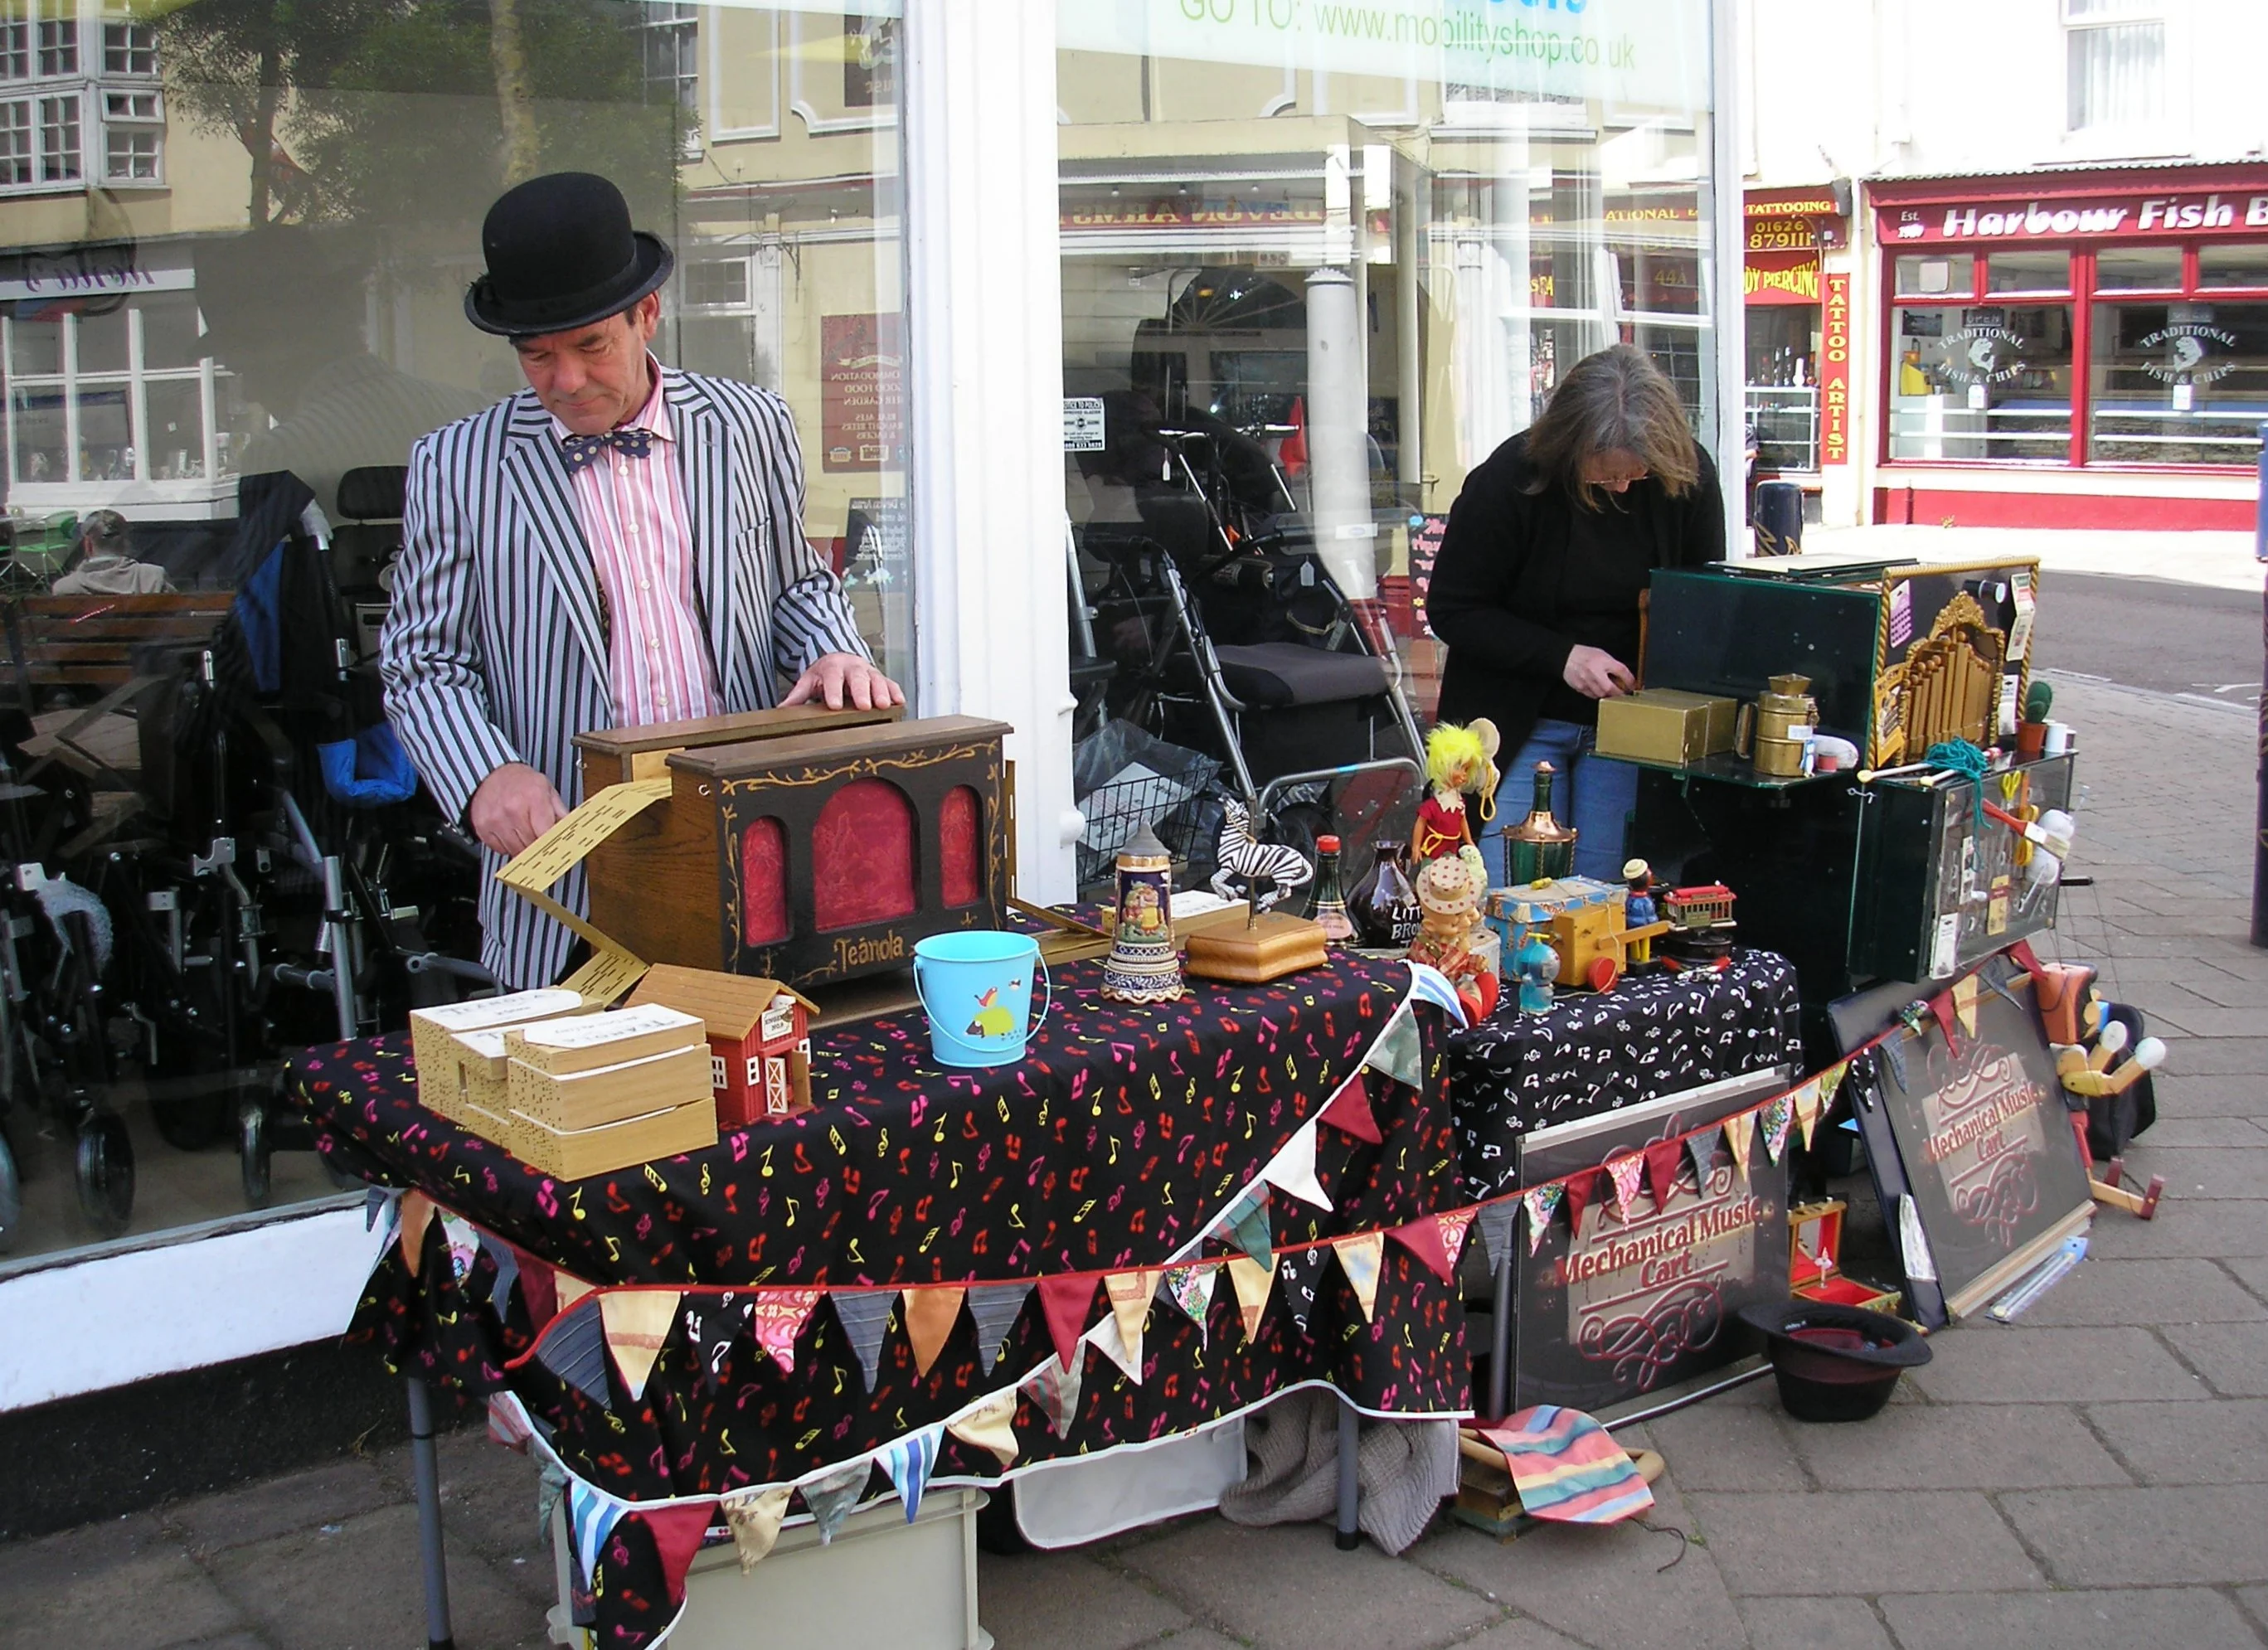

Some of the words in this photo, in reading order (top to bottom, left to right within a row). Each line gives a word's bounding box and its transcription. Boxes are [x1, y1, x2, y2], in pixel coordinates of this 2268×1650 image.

[1315, 7, 1636, 71] www.mobilityshop.co.uk
[1746, 201, 1831, 216] TATTOOING
[1755, 220, 1804, 234] 01626
[1942, 202, 2128, 238] Harbour
[2137, 194, 2234, 230] Fish
[1762, 259, 1819, 301] PIERCING
[1827, 279, 1847, 362] TATTOO
[1938, 327, 2024, 349] TRADITIONAL
[2139, 324, 2236, 348] TRADITIONAL
[1938, 362, 1969, 383] FISH
[1985, 361, 2026, 383] CHIPS
[2140, 362, 2173, 384] FISH
[2176, 374, 2188, 385] &
[2192, 362, 2236, 385] CHIPS
[1827, 377, 1846, 460] ARTIST
[1391, 905, 1424, 921] LITT
[1921, 1099, 2003, 1163] Mechanical
[1996, 1078, 2041, 1119] Music
[1974, 1126, 2007, 1162] Cart
[1553, 1212, 1697, 1286] Mechanical
[1697, 1194, 1762, 1241] Music
[1639, 1246, 1693, 1288] Cart
